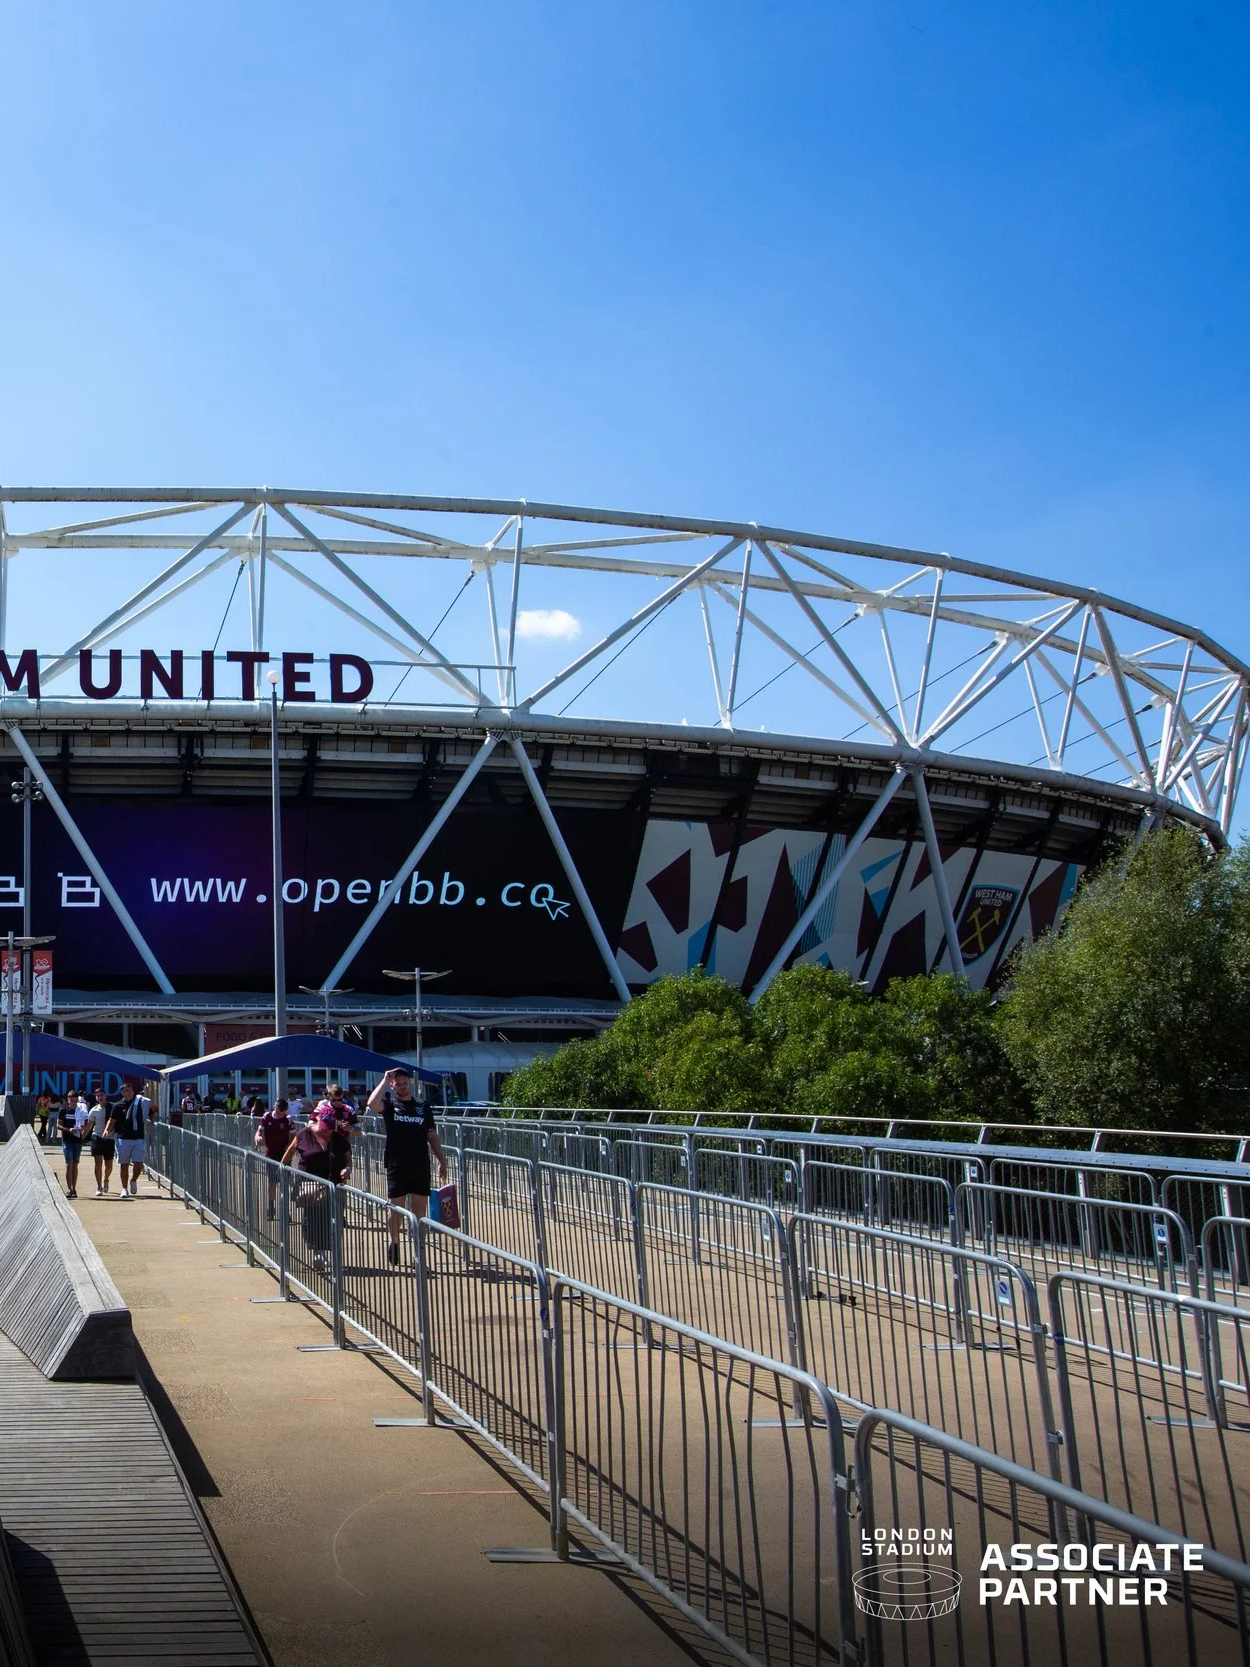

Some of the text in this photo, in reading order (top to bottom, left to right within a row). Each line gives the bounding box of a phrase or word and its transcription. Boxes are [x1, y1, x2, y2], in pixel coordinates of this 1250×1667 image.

[80, 648, 374, 704] UNITED
[150, 871, 556, 913] www.openbb.co
[975, 889, 1013, 902] WEST HAM
[980, 898, 1002, 907] UNITED
[20, 1070, 124, 1097] UNITED
[393, 1112, 425, 1125] betway
